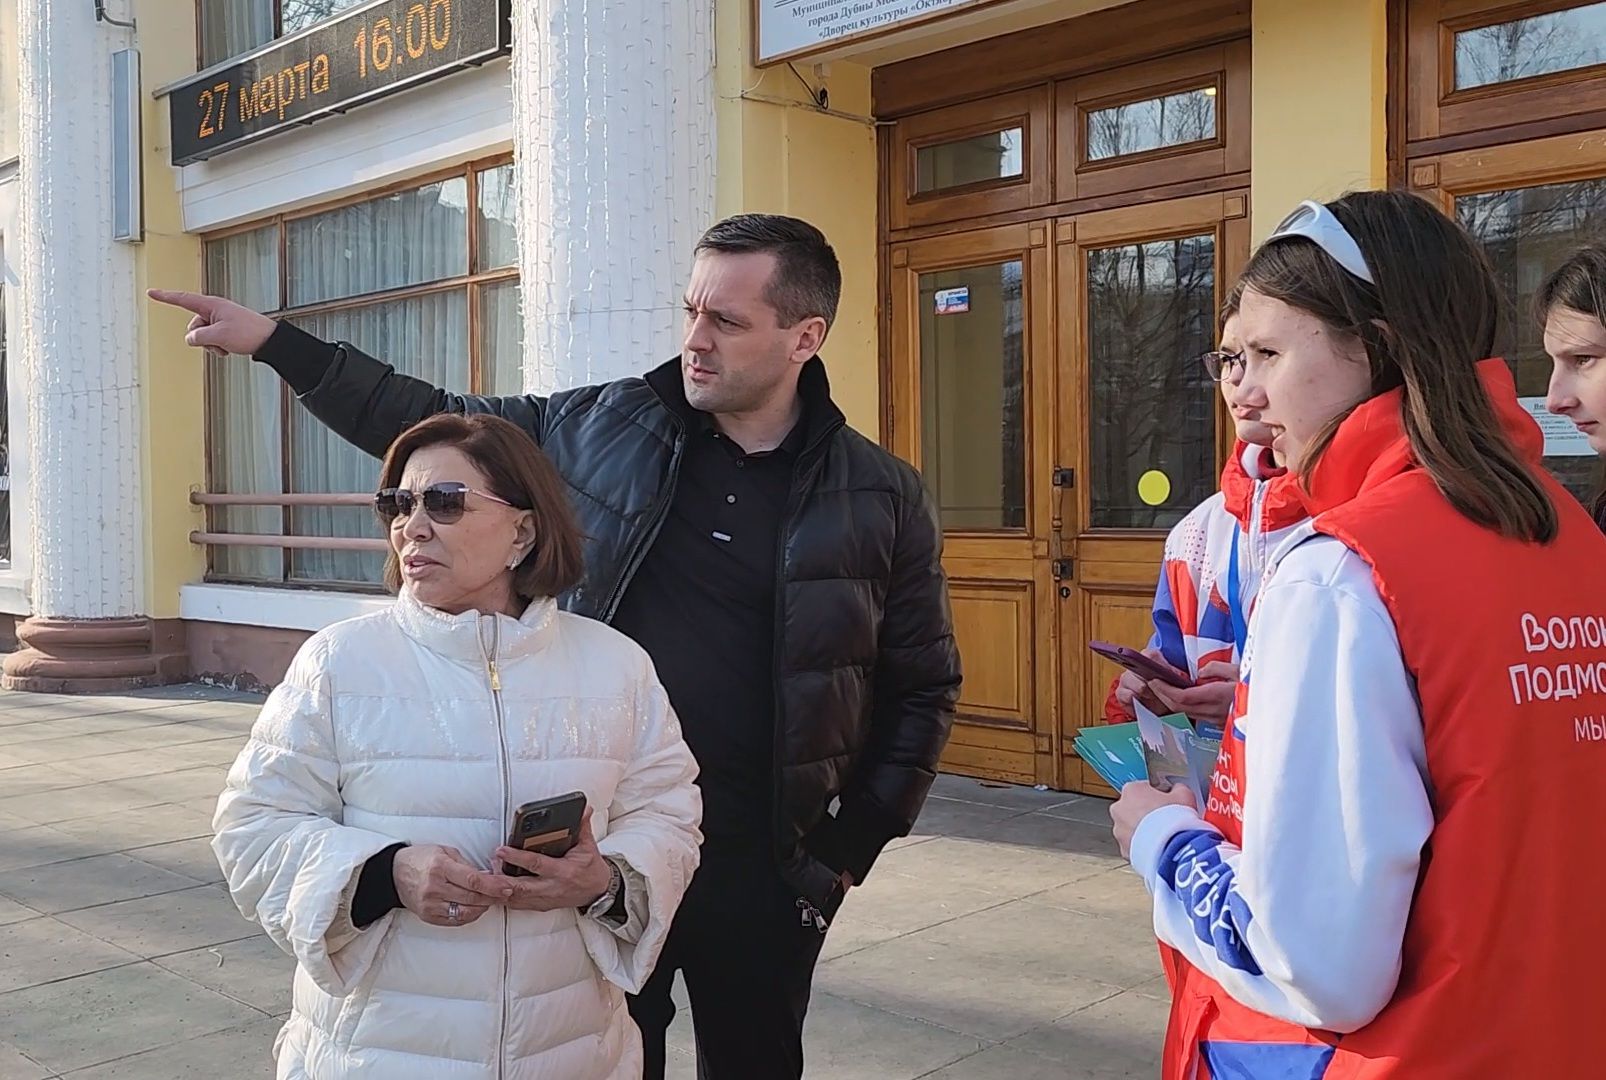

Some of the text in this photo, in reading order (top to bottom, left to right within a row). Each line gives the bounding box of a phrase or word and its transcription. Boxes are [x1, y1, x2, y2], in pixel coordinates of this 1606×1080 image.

[808, 12, 839, 27] города
[840, 3, 874, 19] Дубны
[818, 21, 858, 39] «Дворец
[860, 6, 908, 28] культуры
[198, 0, 452, 138] 27 марта 16:00
